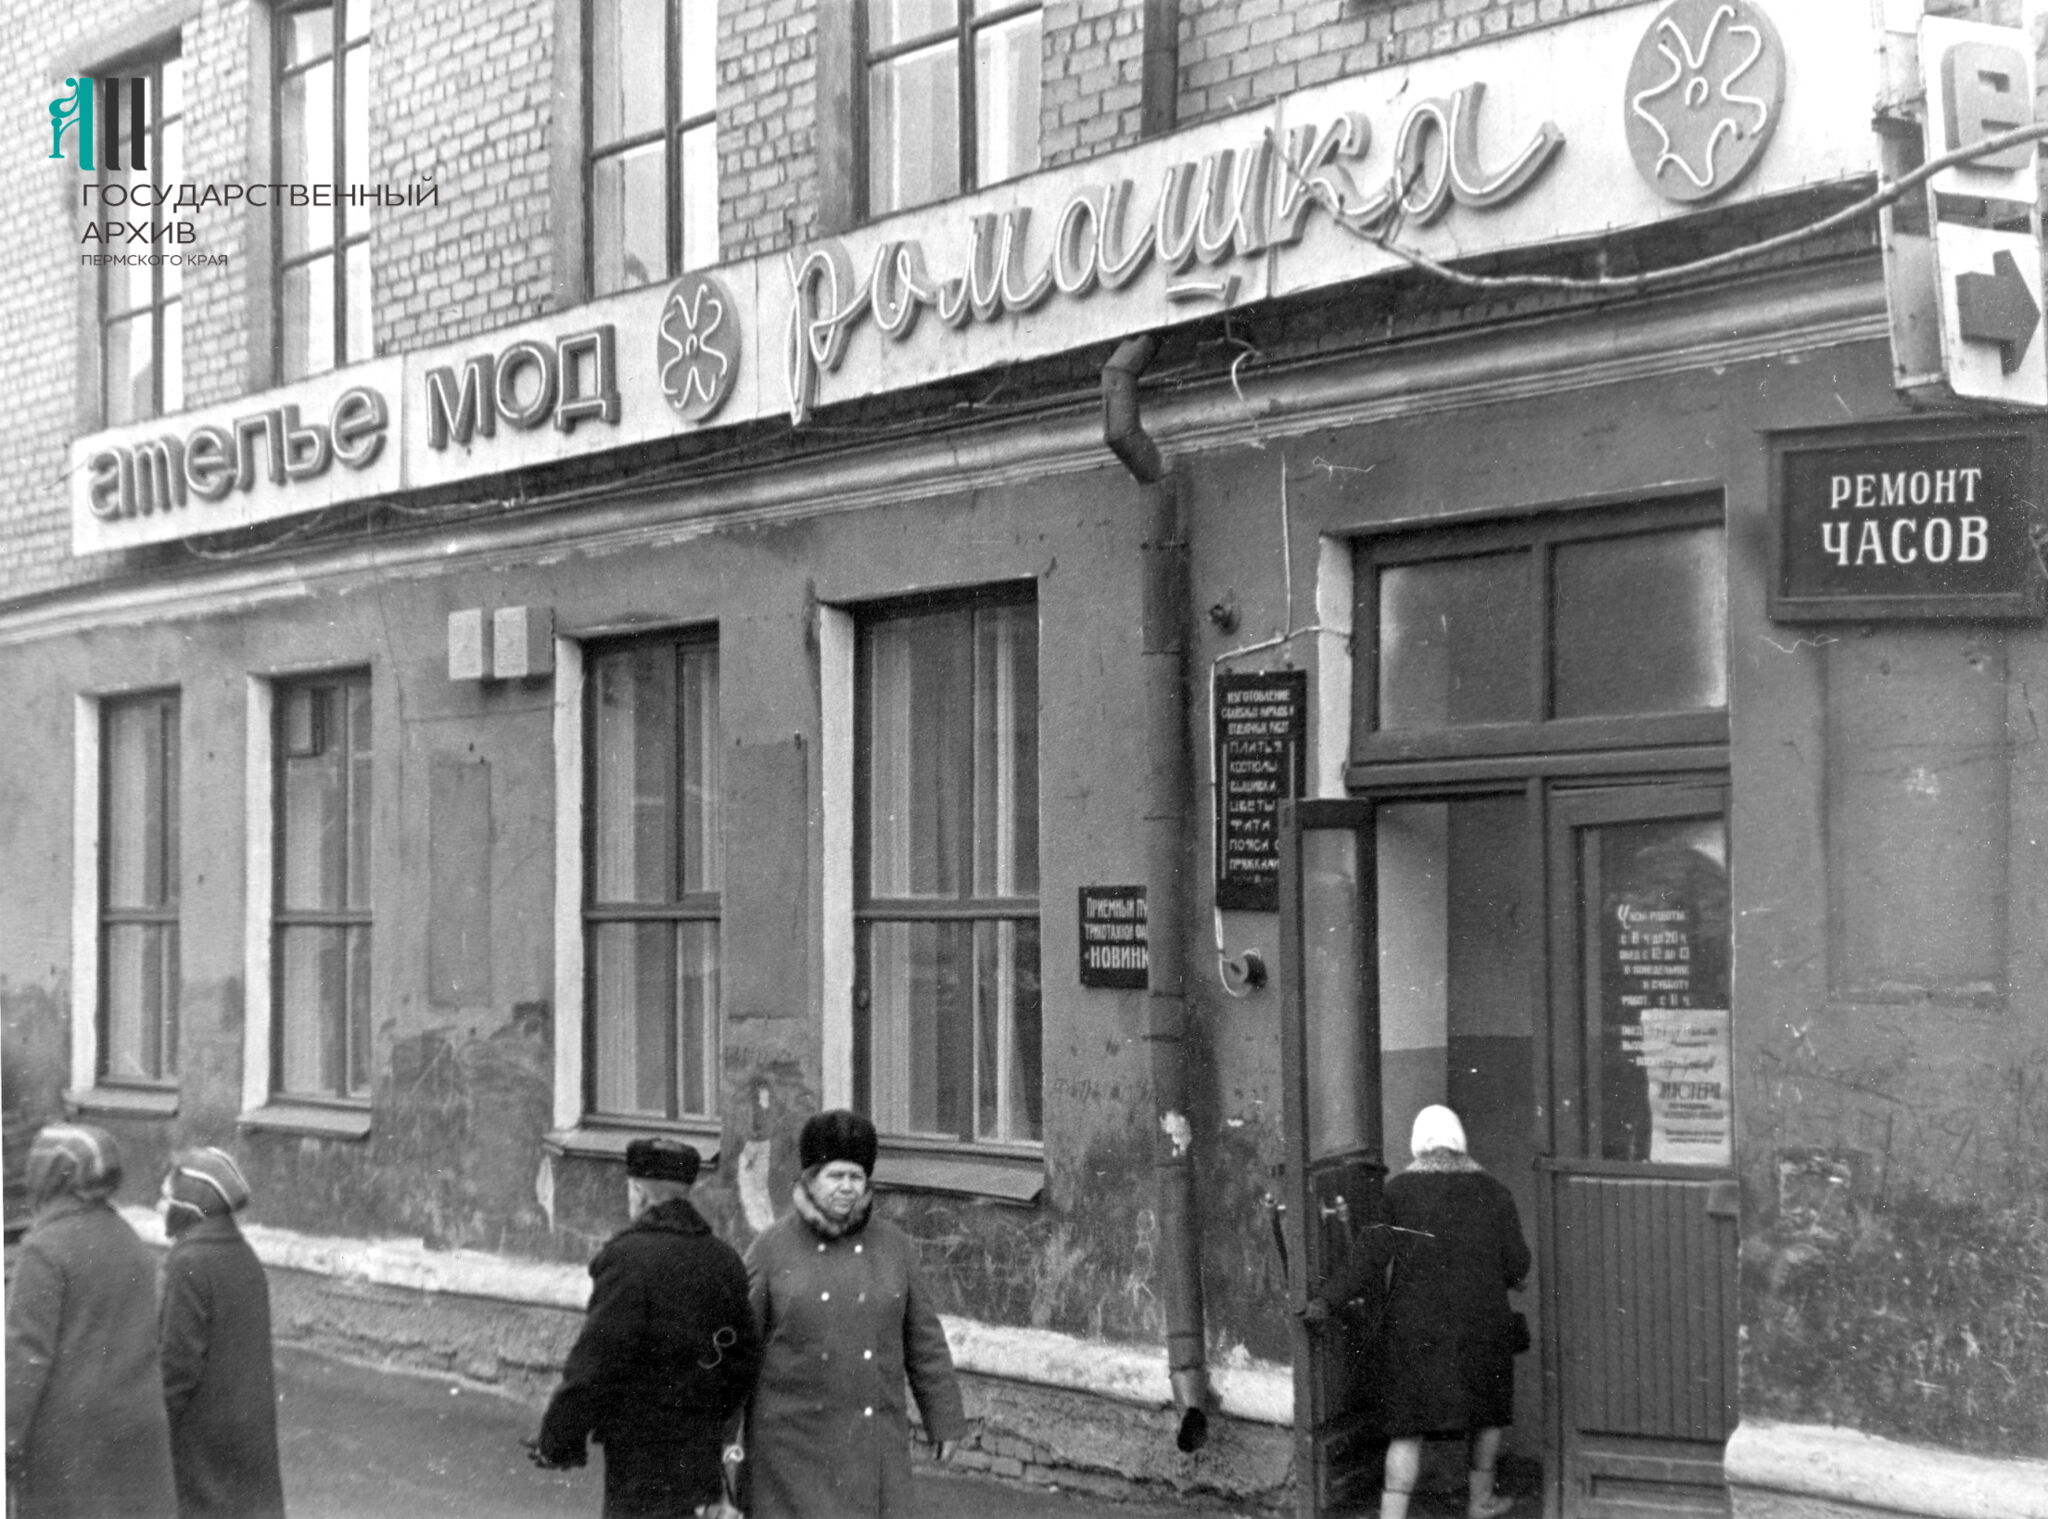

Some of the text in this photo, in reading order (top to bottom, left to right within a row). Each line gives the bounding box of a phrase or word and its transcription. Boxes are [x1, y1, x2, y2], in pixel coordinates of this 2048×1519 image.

[787, 82, 1565, 427] ромашка
[87, 324, 623, 522] ателье мод
[1831, 468, 1983, 509] РЕМОНТ
[1822, 516, 1989, 566] ЧАСОВ
[1229, 741, 1283, 753] ПЛАТЬЯ
[1229, 760, 1278, 773] КОСТЮМЫ
[1230, 780, 1277, 792] ВЫШИВКА
[1229, 800, 1275, 812] ЦВЕТЫ
[1230, 819, 1270, 831] ФАТА
[1229, 838, 1269, 851] ПОЯСА
